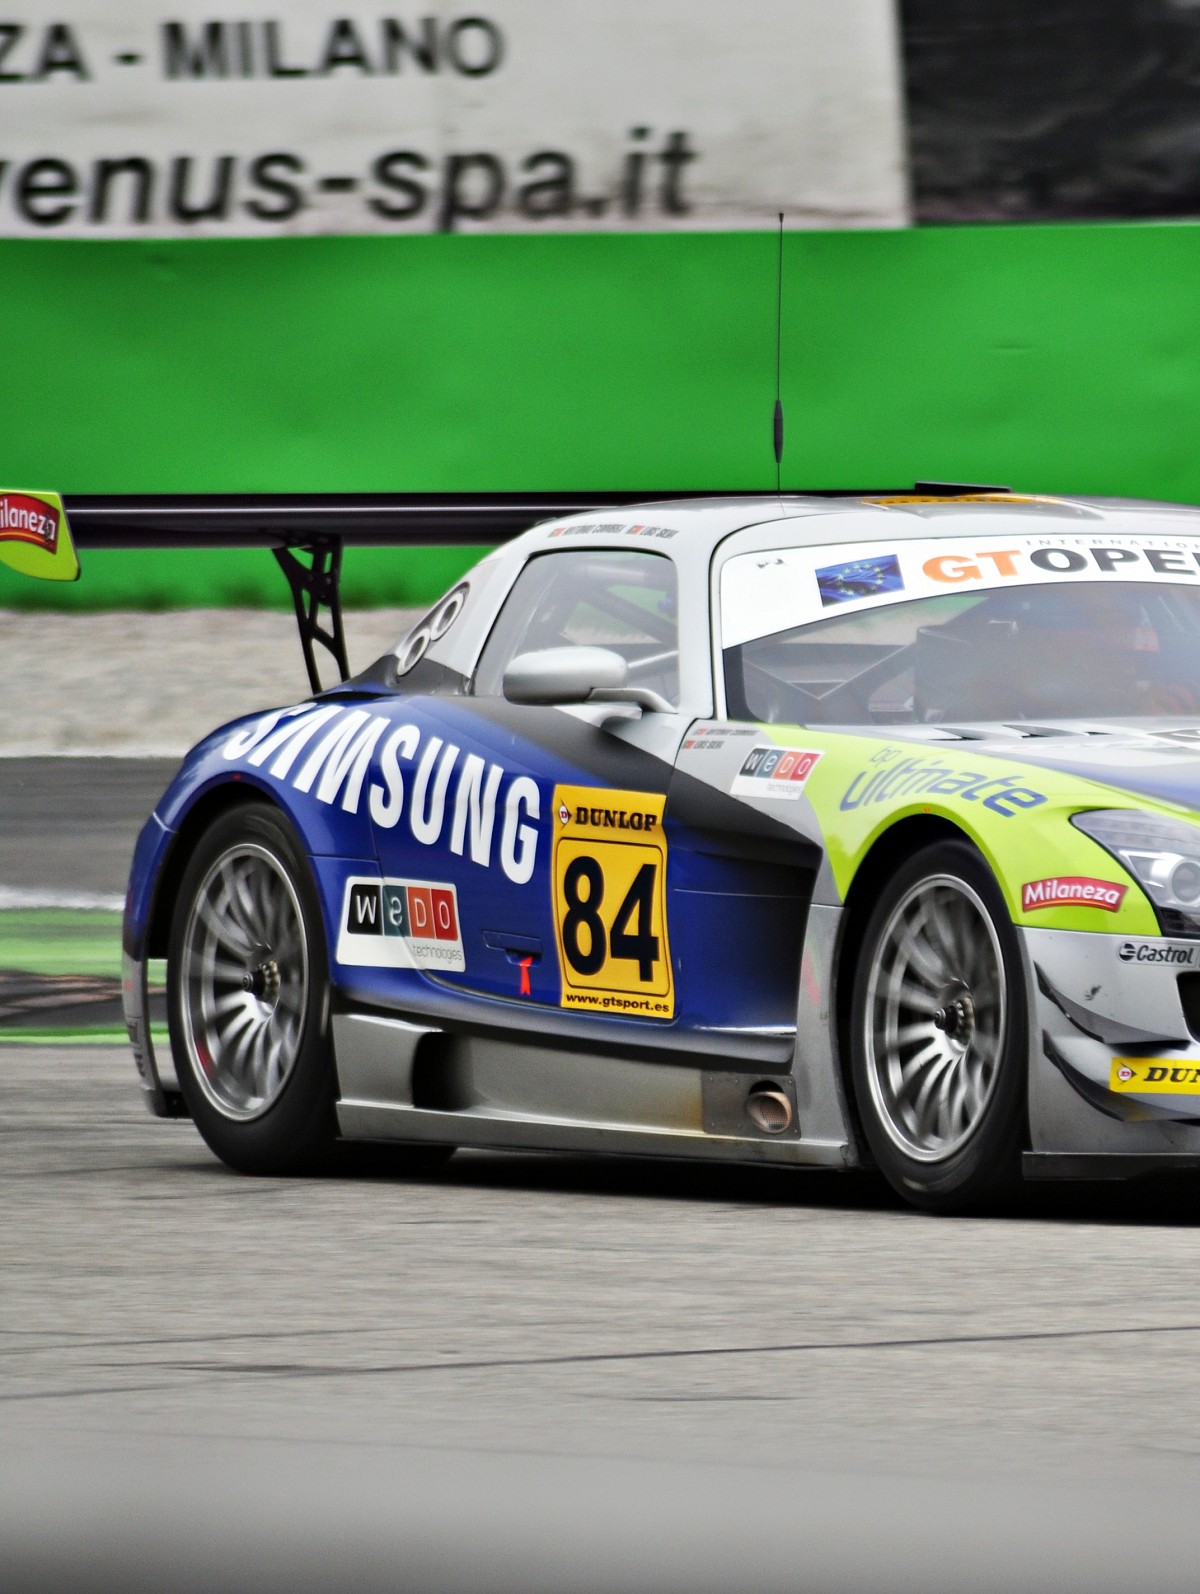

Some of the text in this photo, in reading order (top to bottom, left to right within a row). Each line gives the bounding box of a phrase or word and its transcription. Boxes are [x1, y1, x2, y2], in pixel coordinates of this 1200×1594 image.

[160, 16, 506, 80] MILANO
[0, 125, 700, 233] enus-spa.it
[222, 702, 541, 885] SAMSUNG
[575, 806, 658, 832] DUNLOP
[1025, 879, 1121, 905] Milaneza
[562, 855, 660, 983] 84
[412, 943, 463, 964] technologies
[1136, 944, 1194, 965] Castrol
[566, 993, 670, 1013] www.gtsport.es
